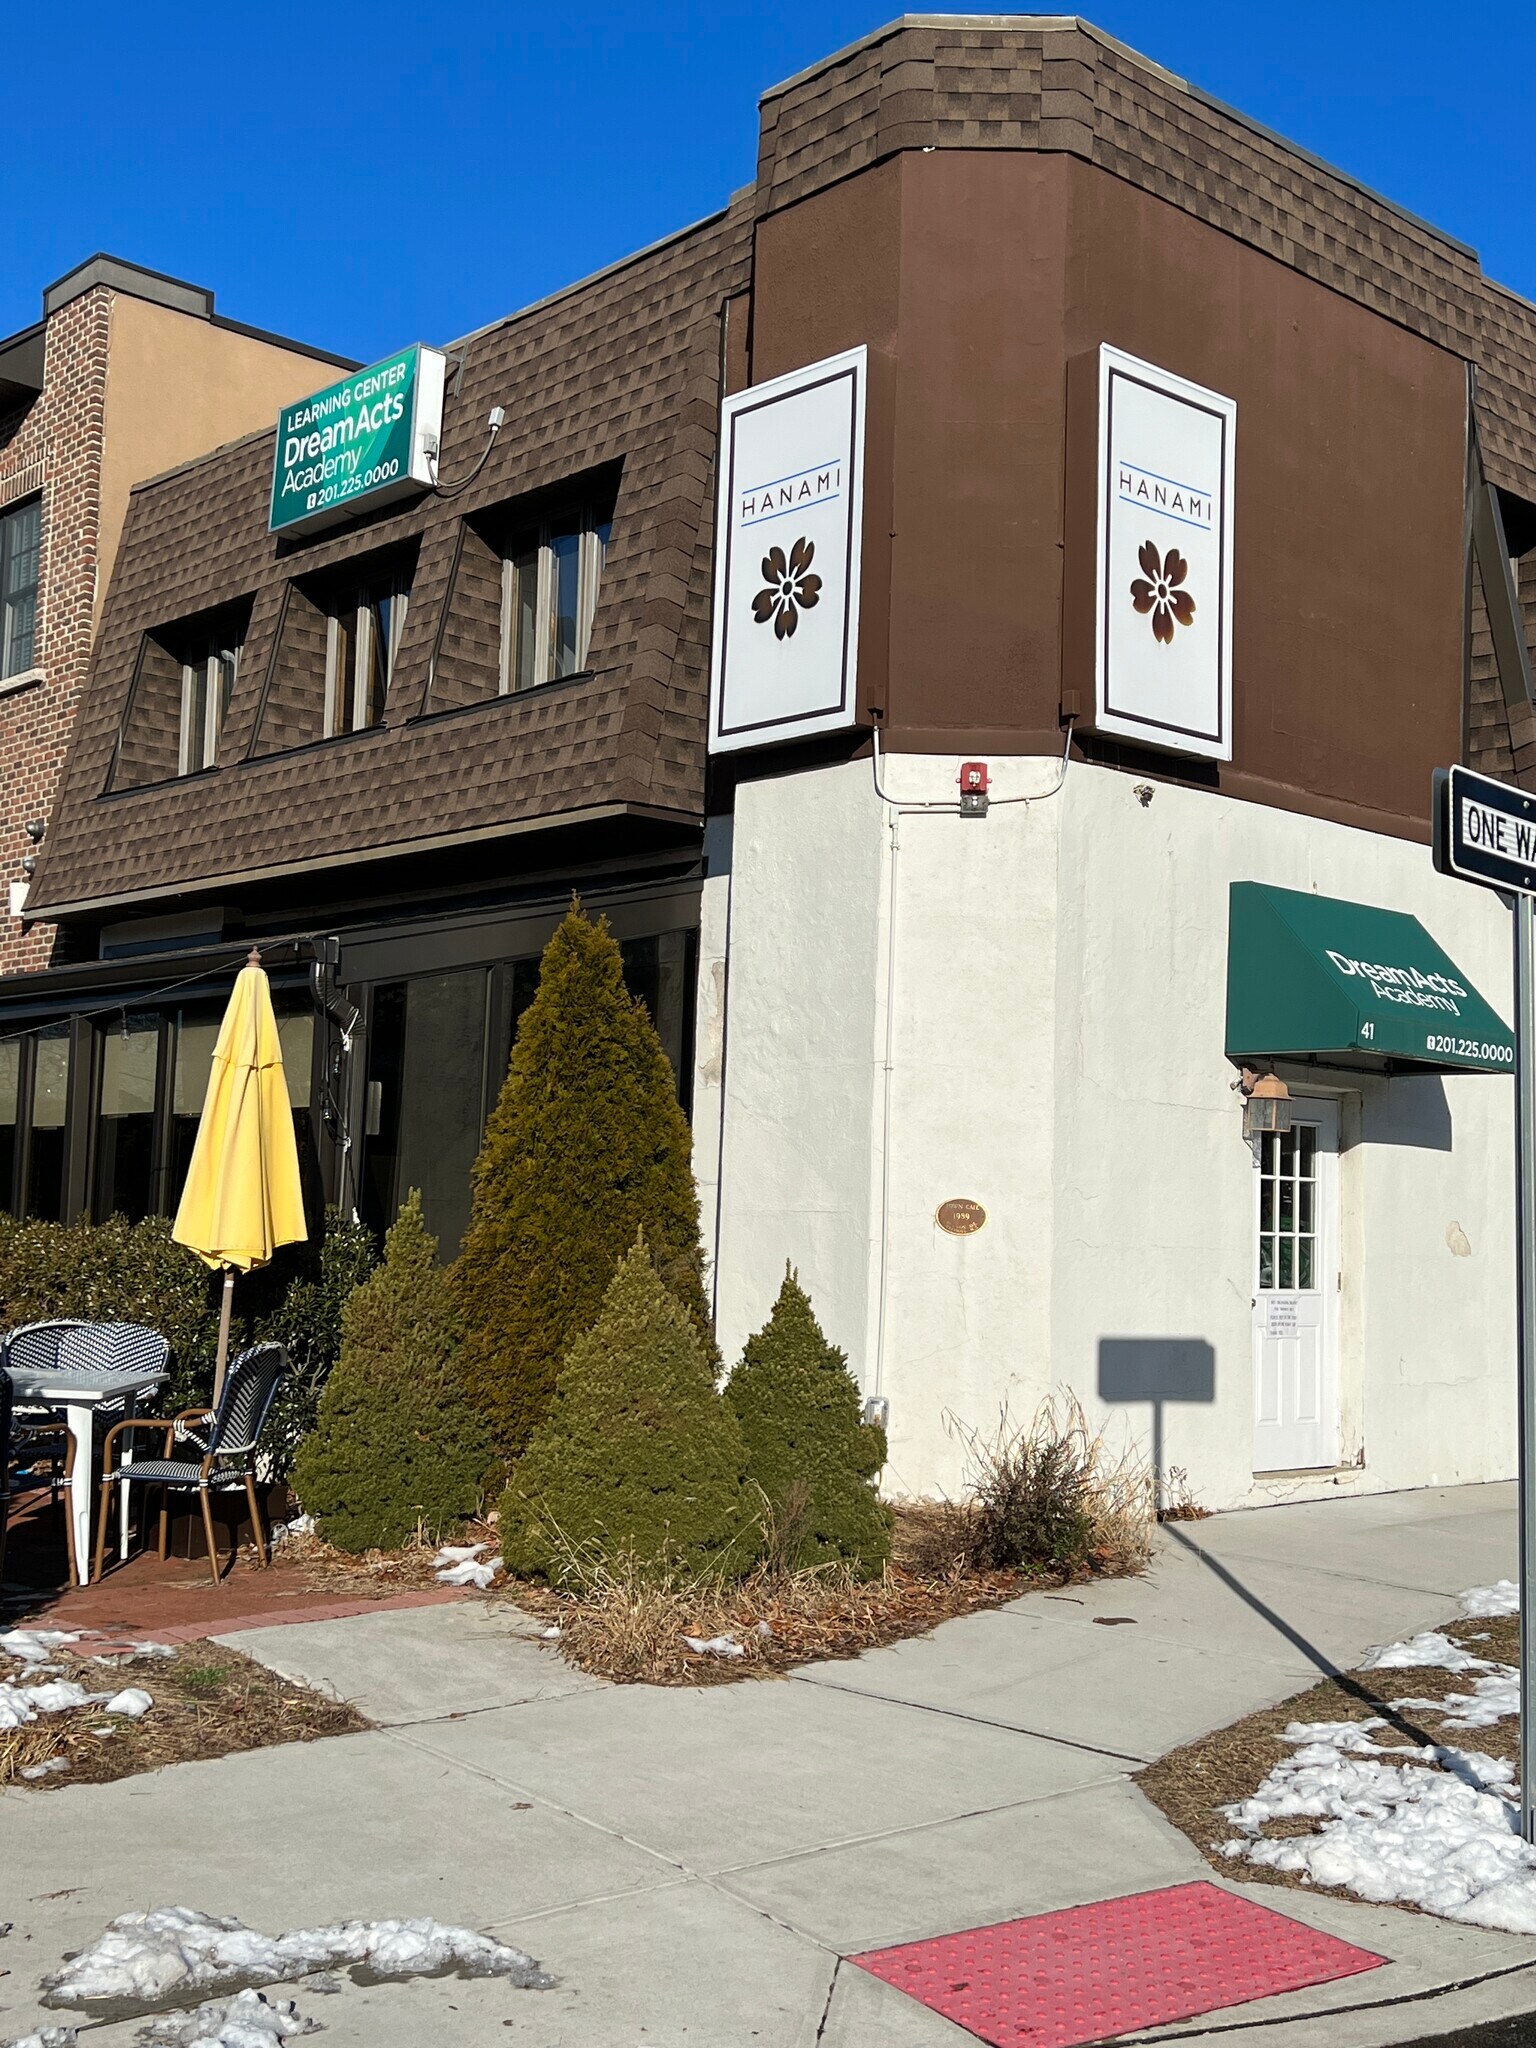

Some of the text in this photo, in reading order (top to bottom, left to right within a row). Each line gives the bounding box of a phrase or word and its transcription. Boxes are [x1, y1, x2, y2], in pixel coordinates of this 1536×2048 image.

[287, 362, 406, 432] LEARNING CENTER
[281, 445, 362, 497] Academy
[742, 468, 840, 518] HANAMI
[1119, 470, 1211, 521] HANAMI
[1468, 805, 1507, 853] ONE
[1370, 979, 1461, 1017] Academy
[1360, 1021, 1374, 1041] 41
